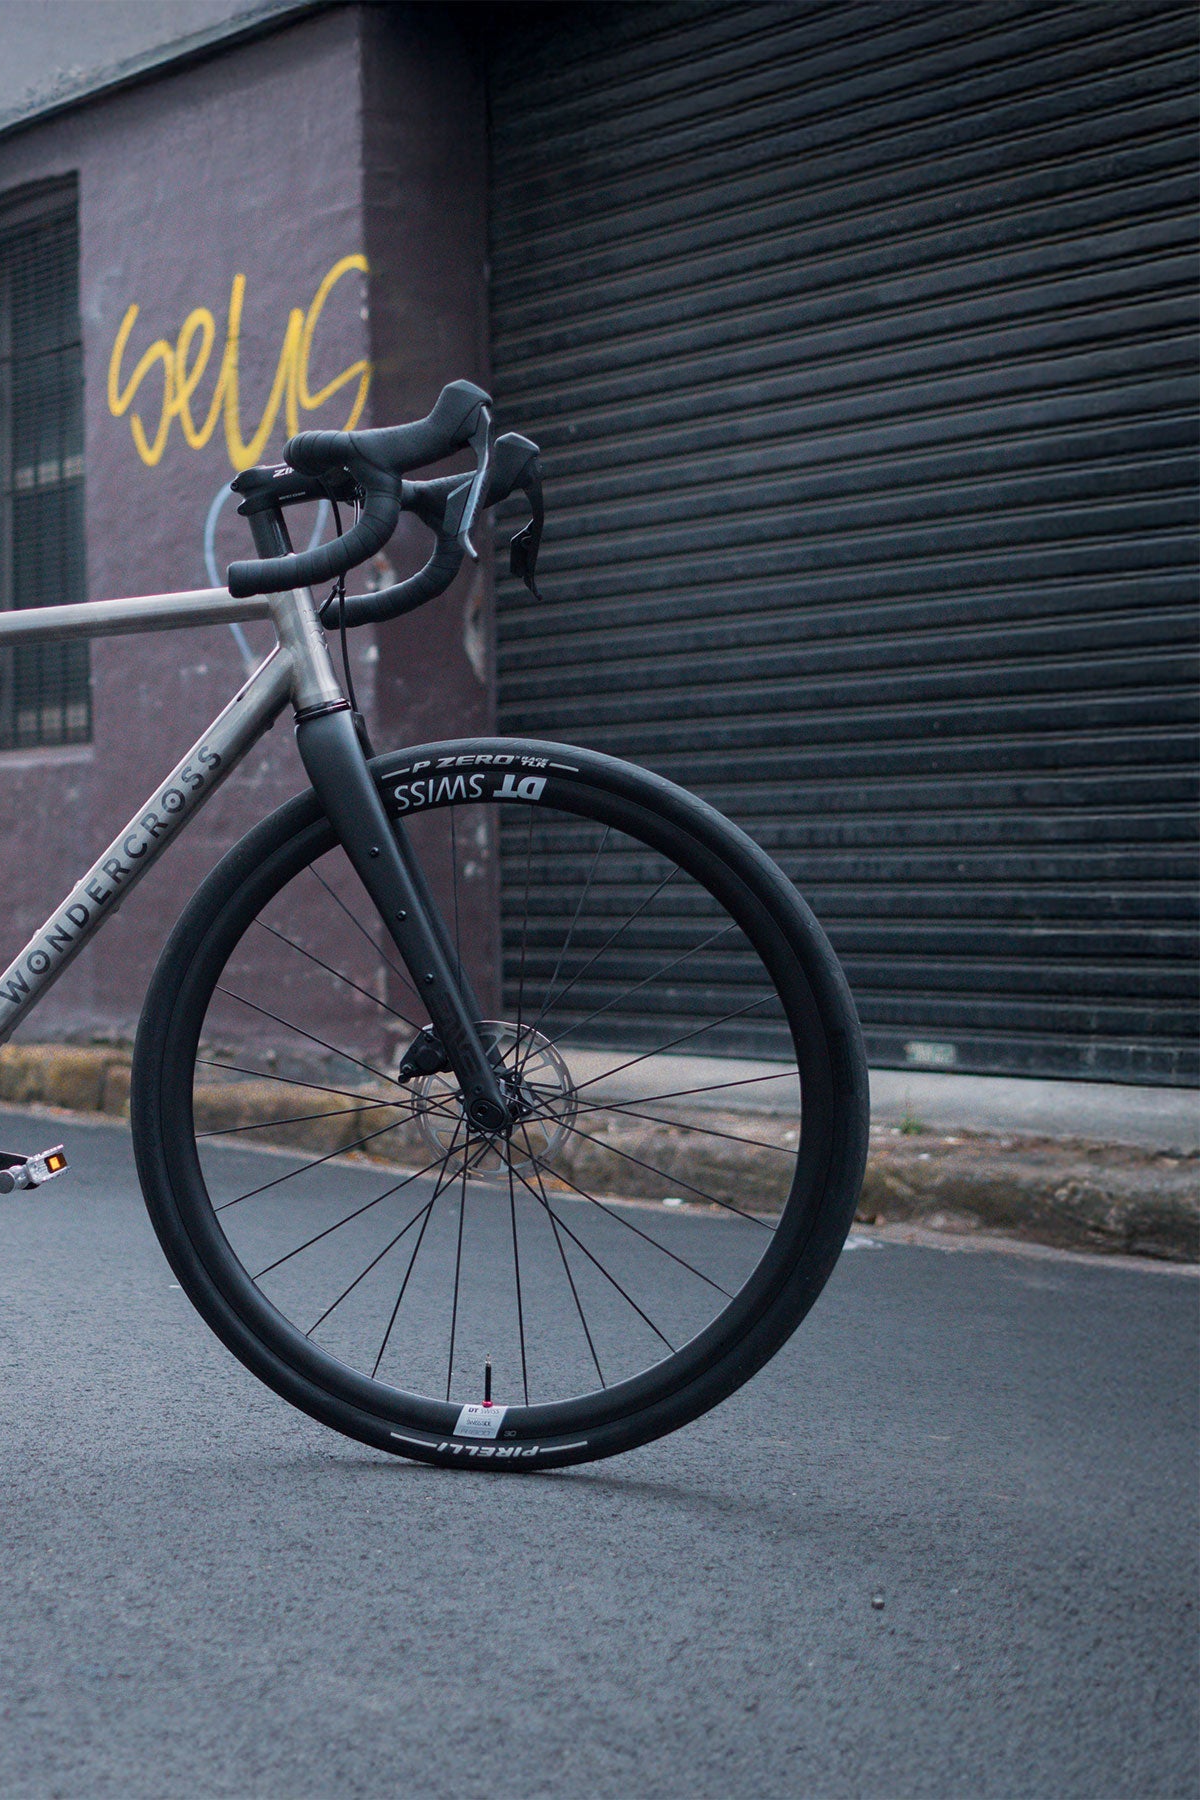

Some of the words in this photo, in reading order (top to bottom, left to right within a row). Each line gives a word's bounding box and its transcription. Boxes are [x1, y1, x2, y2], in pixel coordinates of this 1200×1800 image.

[412, 760, 431, 773] P
[435, 754, 515, 769] ZERO
[394, 773, 485, 810] SWISS
[492, 774, 547, 800] DT
[437, 1442, 539, 1457] PIRELLI
